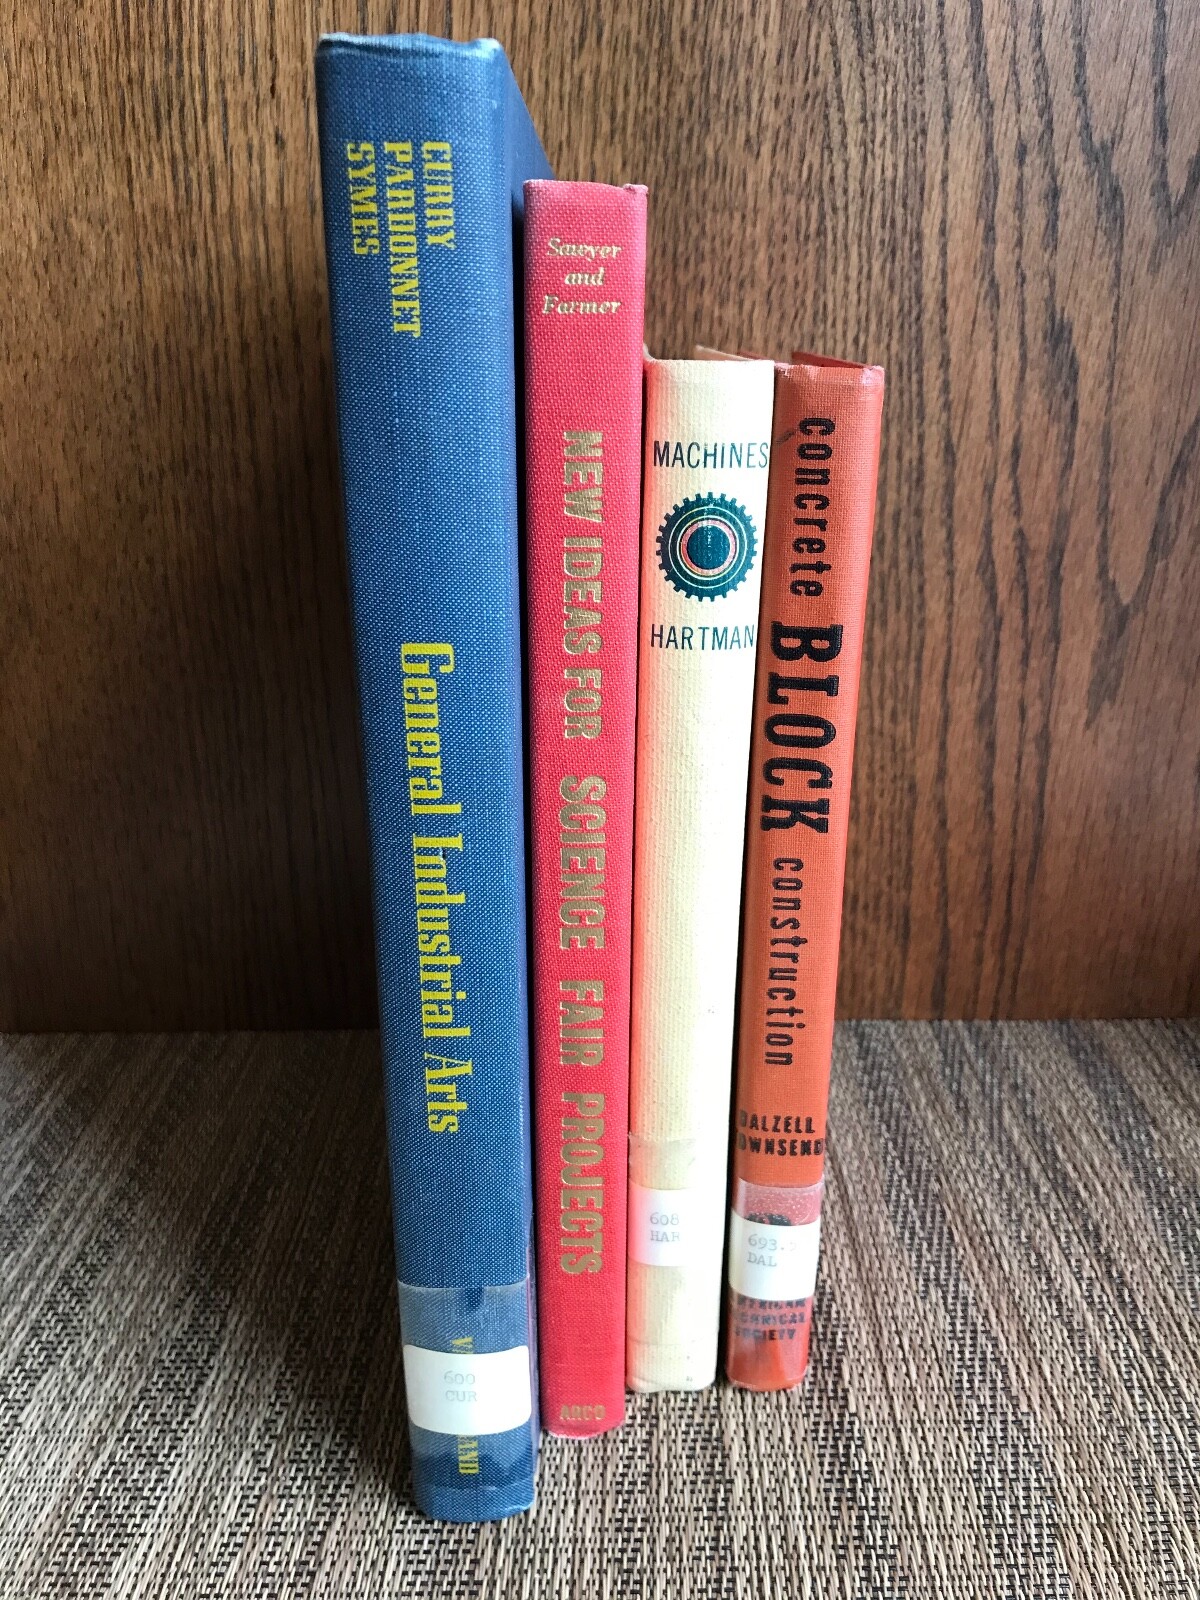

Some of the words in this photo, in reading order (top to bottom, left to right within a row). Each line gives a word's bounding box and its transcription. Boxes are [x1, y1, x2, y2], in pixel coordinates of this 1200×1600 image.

[347, 141, 380, 256] SYMES
[421, 141, 456, 249] CURRY
[384, 141, 421, 338] PARDONNET
[547, 237, 622, 261] Sawyer
[564, 267, 605, 286] and
[542, 295, 622, 314] Farmer
[563, 430, 603, 524] NEW
[653, 441, 769, 469] MACHINES
[790, 417, 836, 597] concrete
[563, 536, 603, 655] IDEAS
[650, 624, 755, 651] HARTMAN
[401, 642, 462, 816] General
[563, 668, 603, 739] FOR
[760, 621, 844, 833] BLOCK
[559, 775, 607, 950] SCIENCE
[413, 833, 472, 1039] Industrial
[764, 857, 808, 1065] construction
[559, 980, 605, 1067] FAIR
[424, 1052, 473, 1133] Arts
[739, 1110, 815, 1133] DALZELL
[560, 1092, 606, 1275] PROJECTS
[736, 1132, 823, 1156] OWNSEND
[650, 1211, 680, 1226] 608
[747, 1251, 777, 1267] DAL
[444, 1370, 476, 1385] 600
[445, 1390, 477, 1403] CUR
[560, 1405, 606, 1421] ARCO
